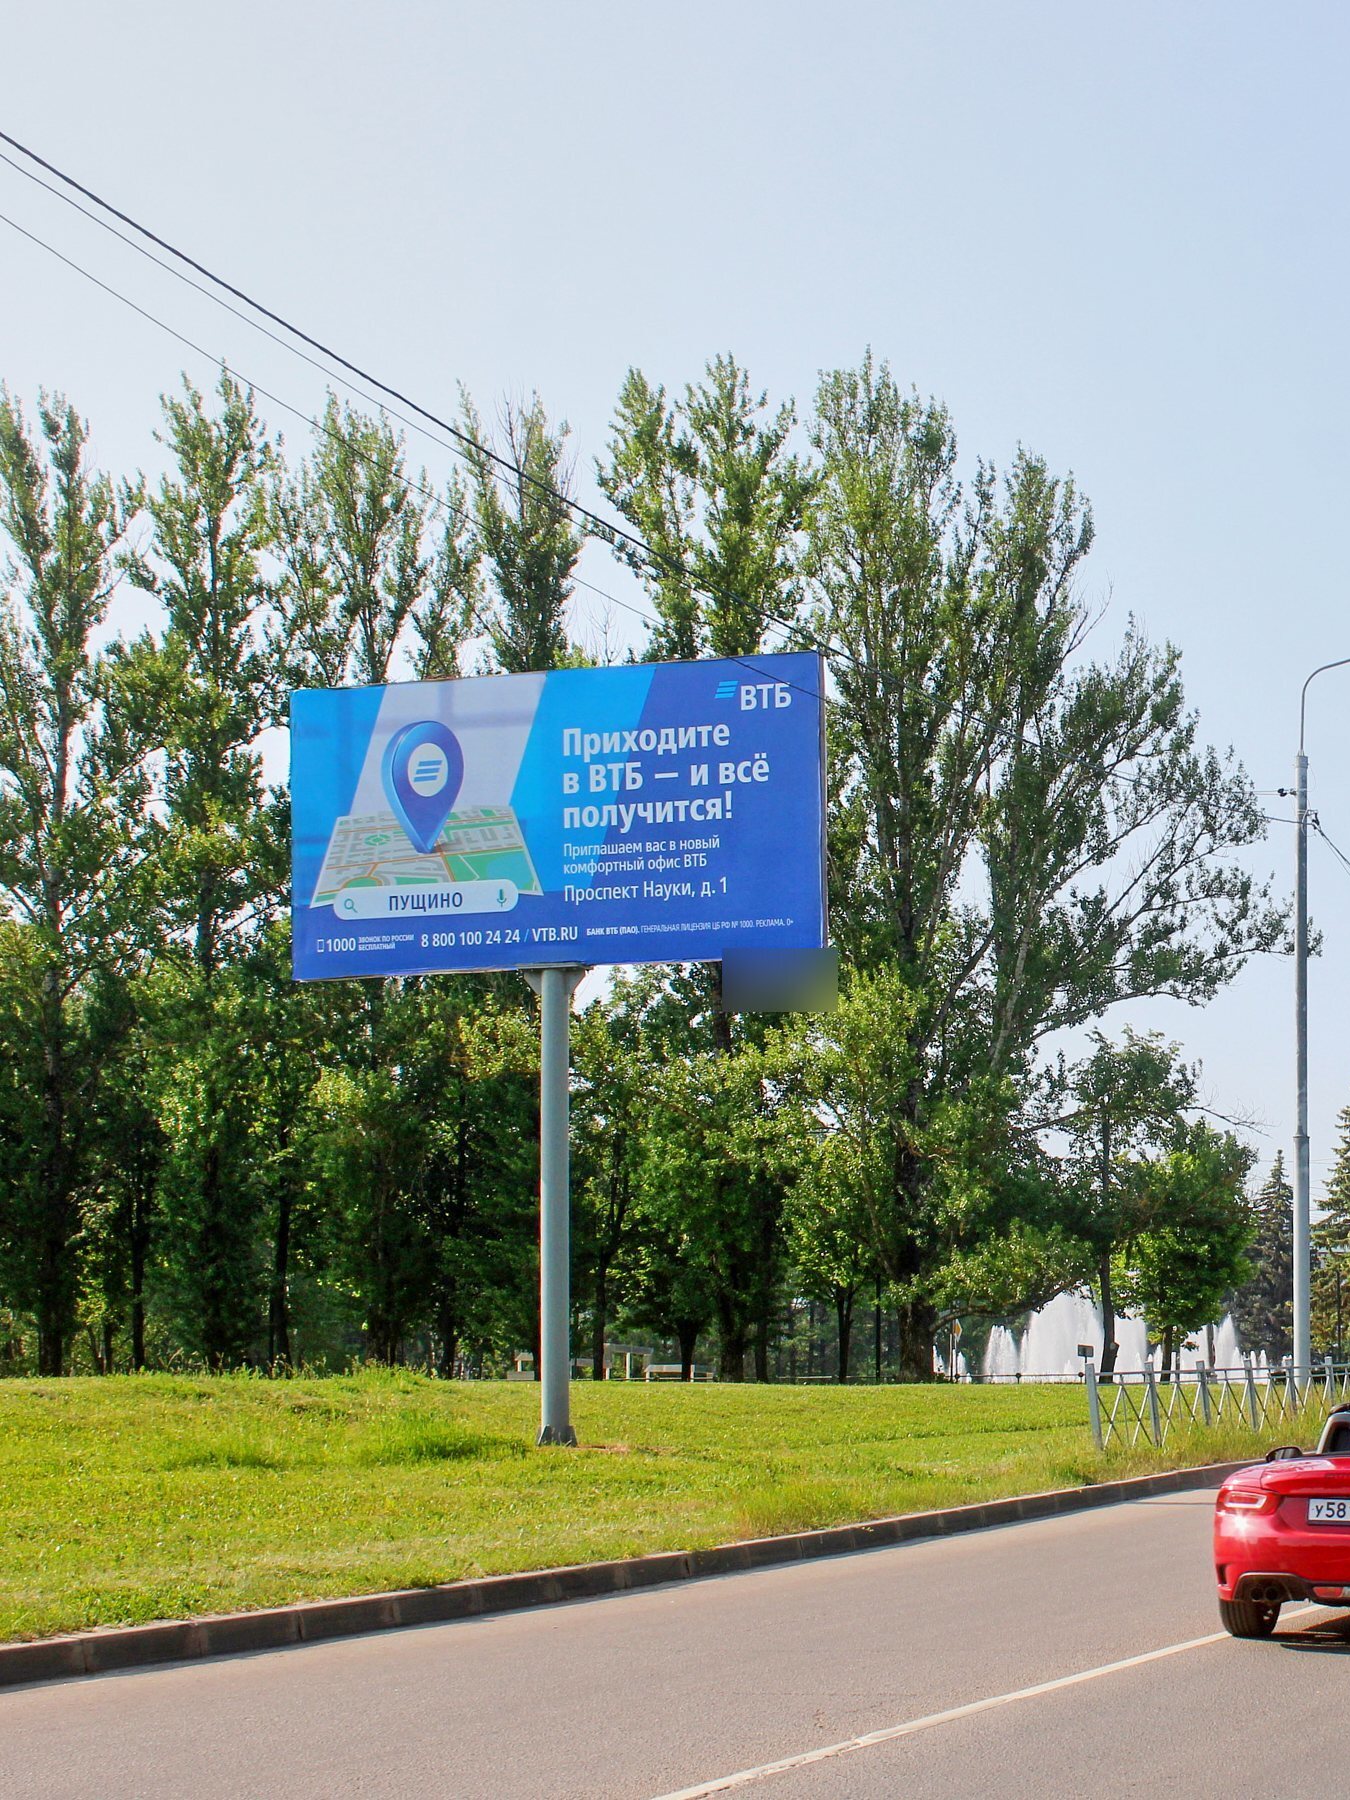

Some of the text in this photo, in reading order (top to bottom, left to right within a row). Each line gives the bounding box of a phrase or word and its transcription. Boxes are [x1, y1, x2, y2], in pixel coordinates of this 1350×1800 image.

[740, 682, 792, 711] ВТБ
[563, 723, 730, 763] Приходите
[563, 772, 580, 794] в
[589, 761, 643, 792] ВТБ
[690, 763, 709, 786] и
[718, 752, 770, 785] всё
[563, 790, 733, 834] получится!
[563, 834, 720, 859] Приглашаем вас в новый
[563, 853, 707, 876] комфортный офис ВТБ
[388, 891, 464, 912] ПУЩИНО
[564, 876, 728, 905] Проспект Науки, д. 1
[421, 934, 429, 948] 8
[432, 932, 456, 947] 800
[459, 931, 483, 945] 100
[486, 930, 502, 944] 24
[504, 929, 521, 943] 24
[532, 926, 579, 942] VTB.RU
[587, 927, 605, 936] БАНК
[606, 926, 619, 935] ВТБ
[326, 937, 356, 952] 1000
